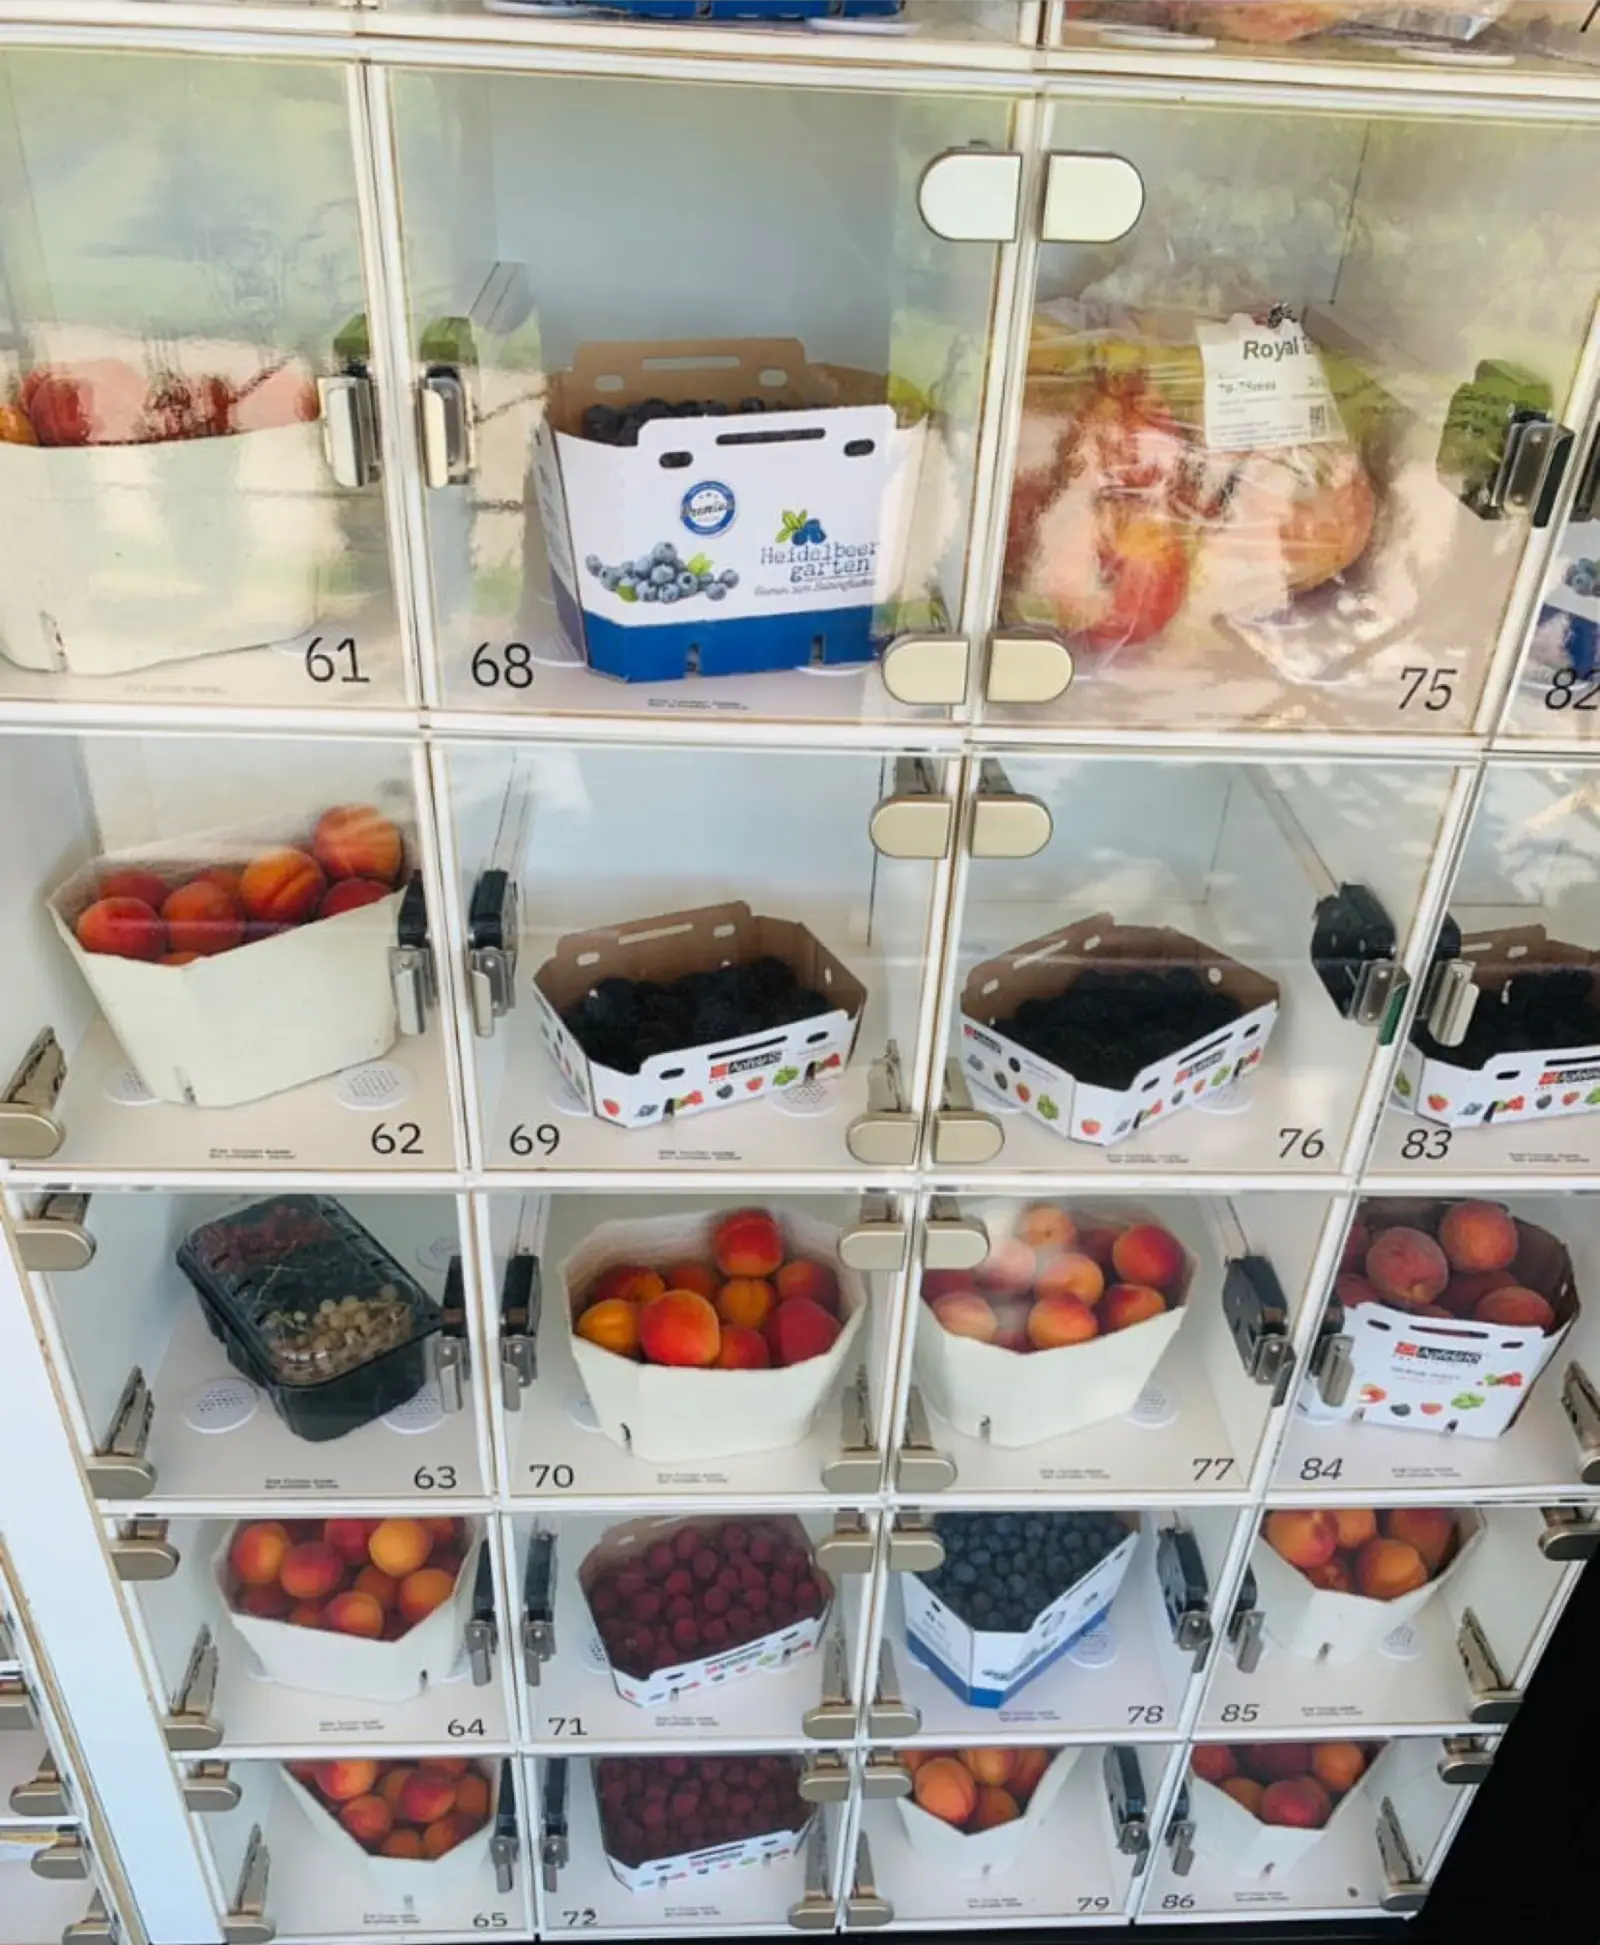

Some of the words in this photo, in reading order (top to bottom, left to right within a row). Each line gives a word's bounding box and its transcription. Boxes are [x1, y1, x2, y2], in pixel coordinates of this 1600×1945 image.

[1242, 335, 1299, 362] Royal
[760, 541, 879, 565] Heidelbeer
[789, 557, 870, 583] garten
[306, 636, 370, 683] 61
[471, 641, 535, 689] 68
[1398, 667, 1458, 712] 75
[1545, 666, 1600, 711] 82
[370, 1122, 425, 1155] 62
[509, 1123, 560, 1156] 69
[1278, 1127, 1325, 1159] 76
[1401, 1128, 1452, 1160] 83
[413, 1465, 457, 1490] 63
[528, 1464, 575, 1489] 70
[1191, 1457, 1235, 1482] 77
[1299, 1457, 1343, 1481] 84
[1126, 1705, 1164, 1724] 78
[1220, 1703, 1259, 1723] 85
[447, 1718, 486, 1738] 64
[548, 1717, 588, 1737] 71
[1076, 1897, 1110, 1913] 79
[1162, 1894, 1196, 1910] 86
[472, 1912, 508, 1928] 65
[562, 1909, 597, 1928] 72
